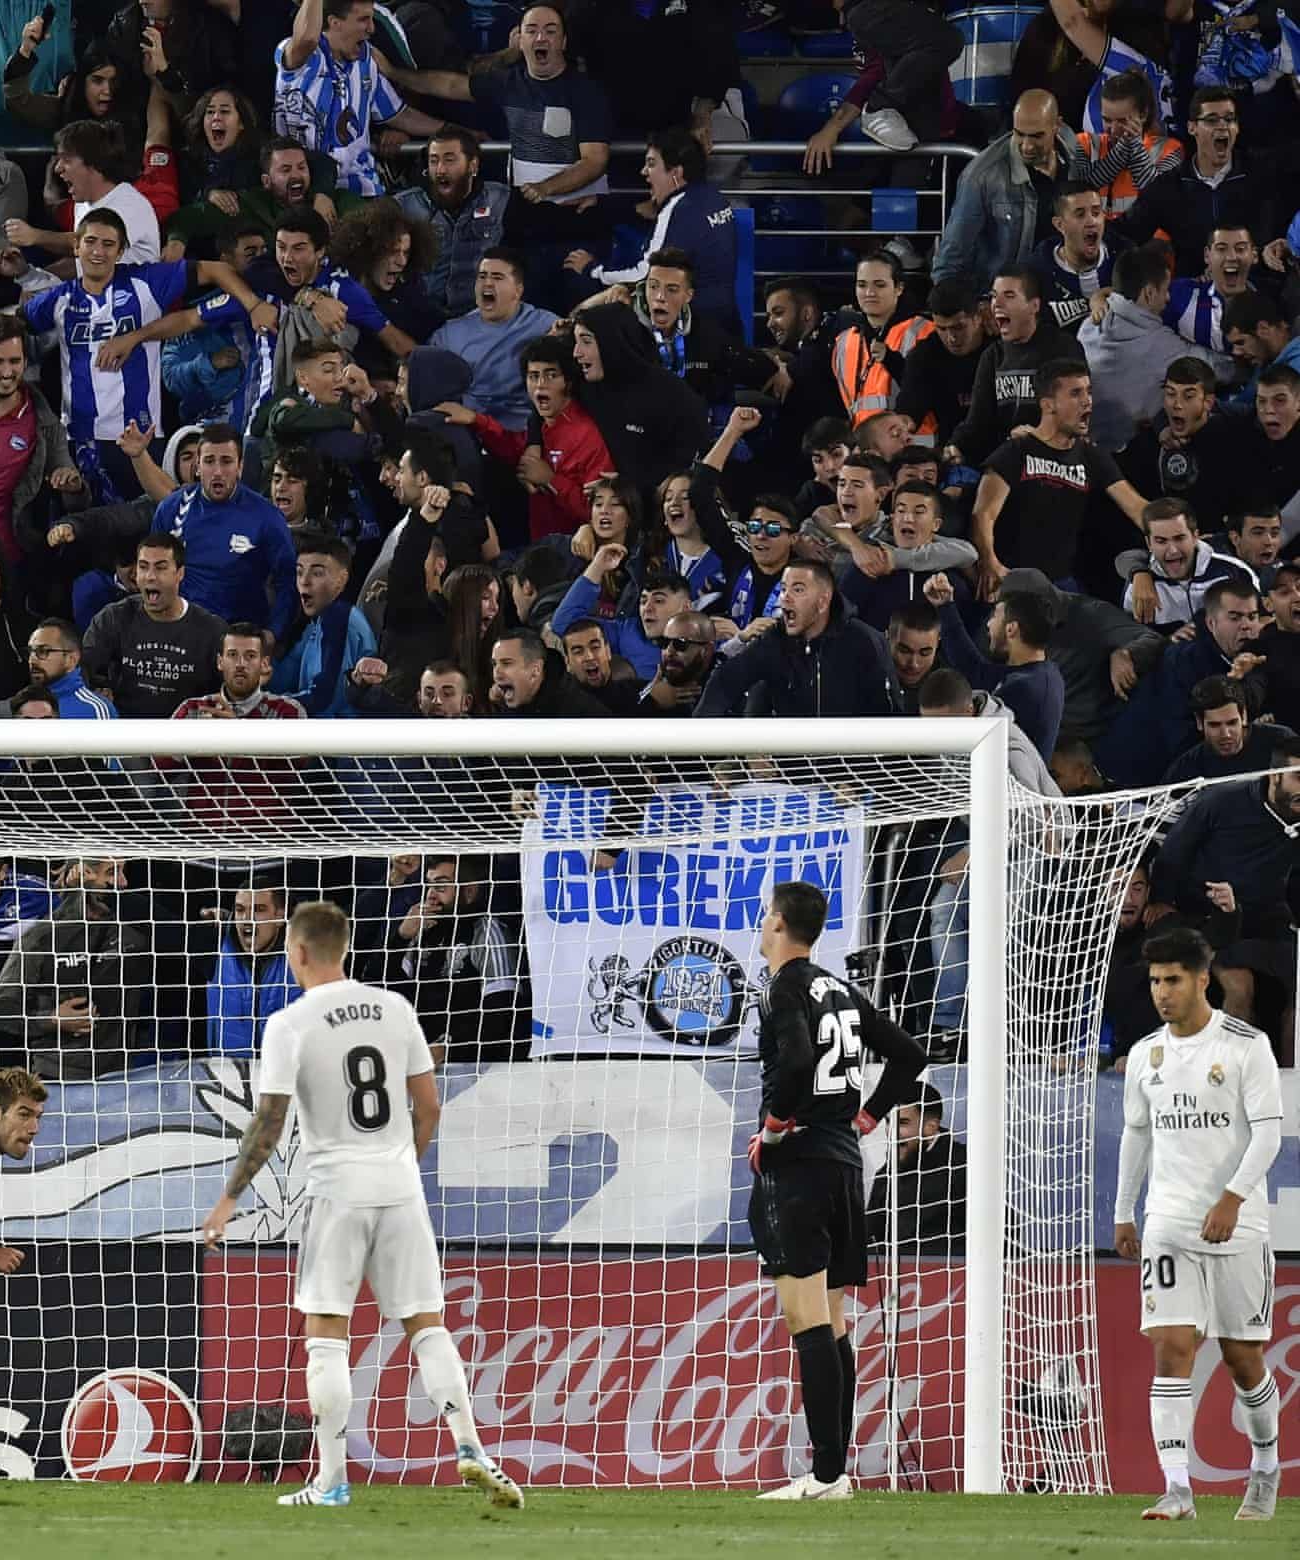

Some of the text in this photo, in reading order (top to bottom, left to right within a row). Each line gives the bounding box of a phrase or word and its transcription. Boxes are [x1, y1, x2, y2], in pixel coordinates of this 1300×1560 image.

[323, 1003, 382, 1029] KROOS
[812, 1007, 862, 1095] 25
[342, 1045, 391, 1133] 8
[1172, 1091, 1198, 1110] Fly
[1154, 1109, 1231, 1130] Emirates
[1142, 1254, 1176, 1291] 20
